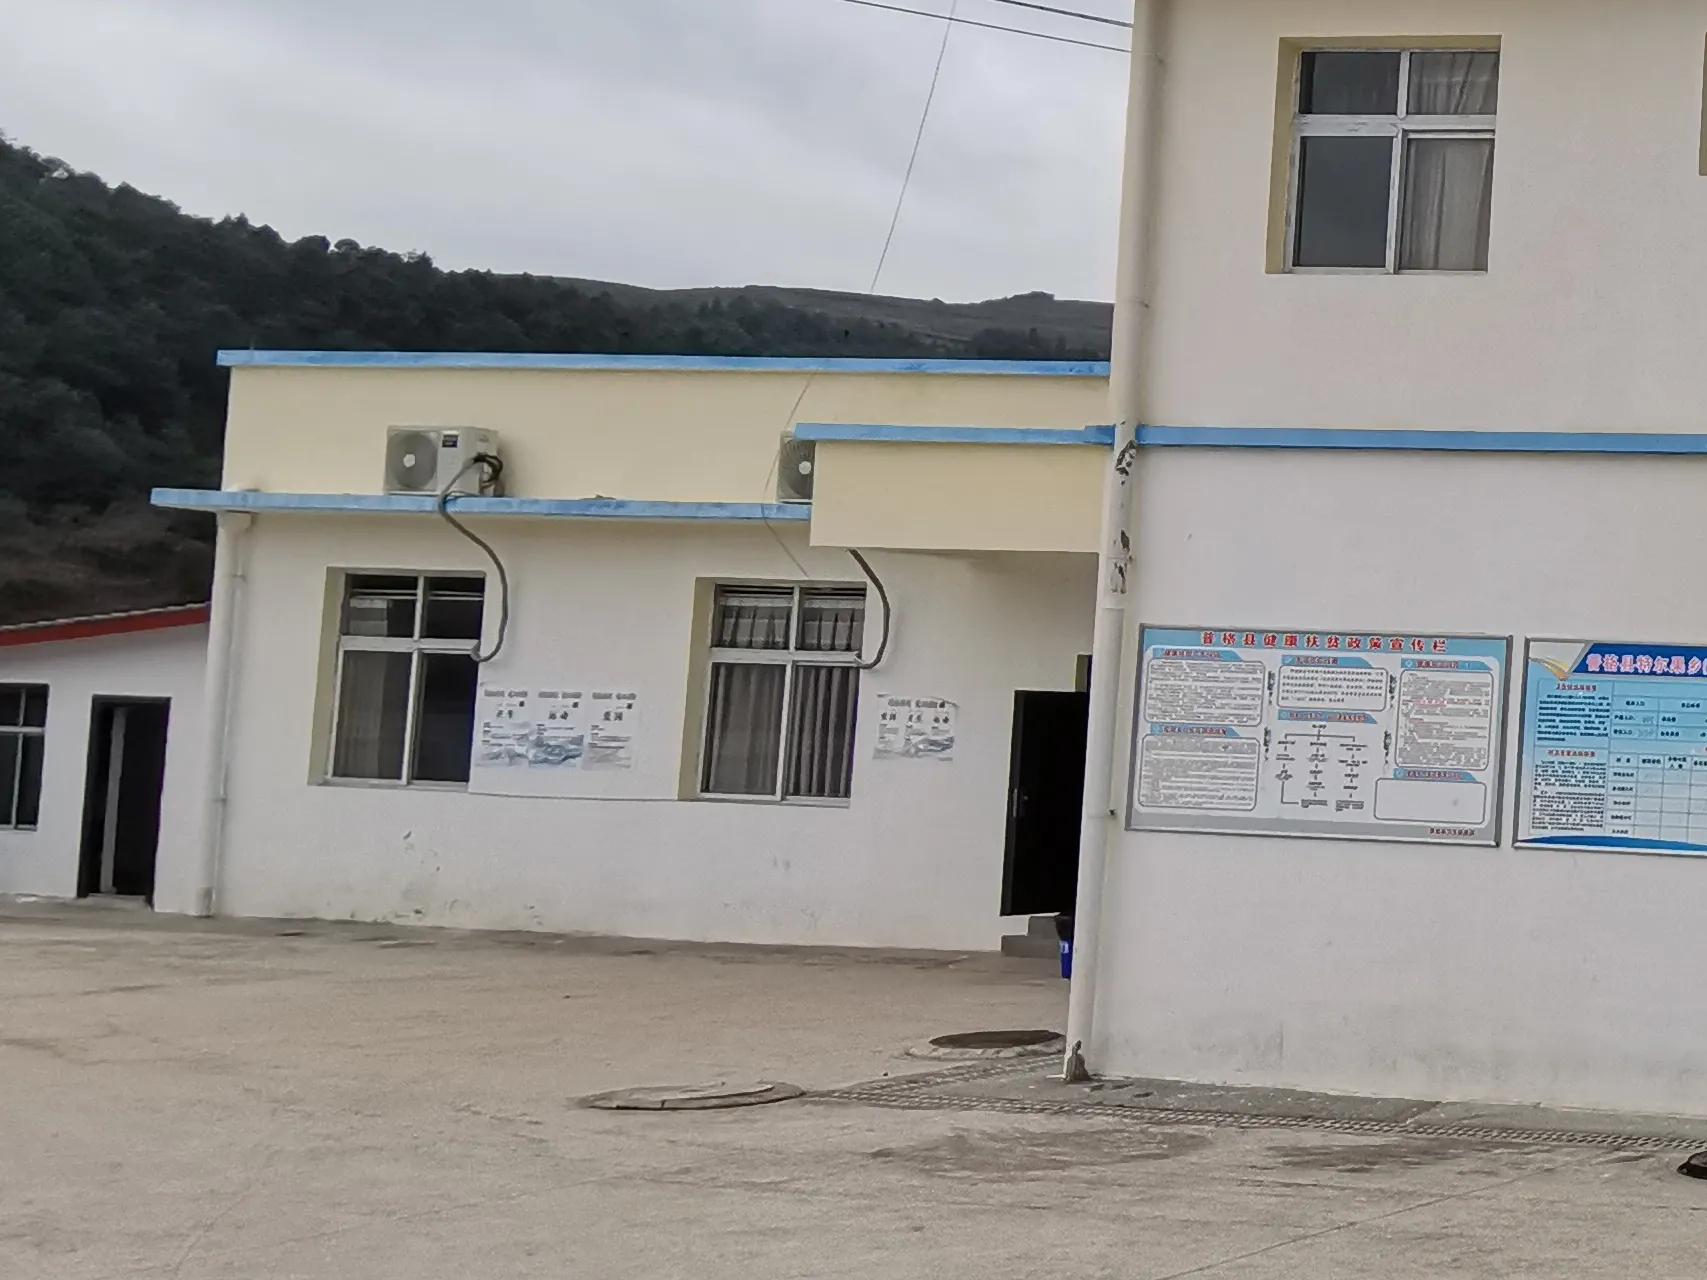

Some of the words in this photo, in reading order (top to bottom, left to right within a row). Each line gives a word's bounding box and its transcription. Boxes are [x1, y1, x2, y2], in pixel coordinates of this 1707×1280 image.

[1201, 629, 1449, 655] 普格县健康扶贫政策宣传栏
